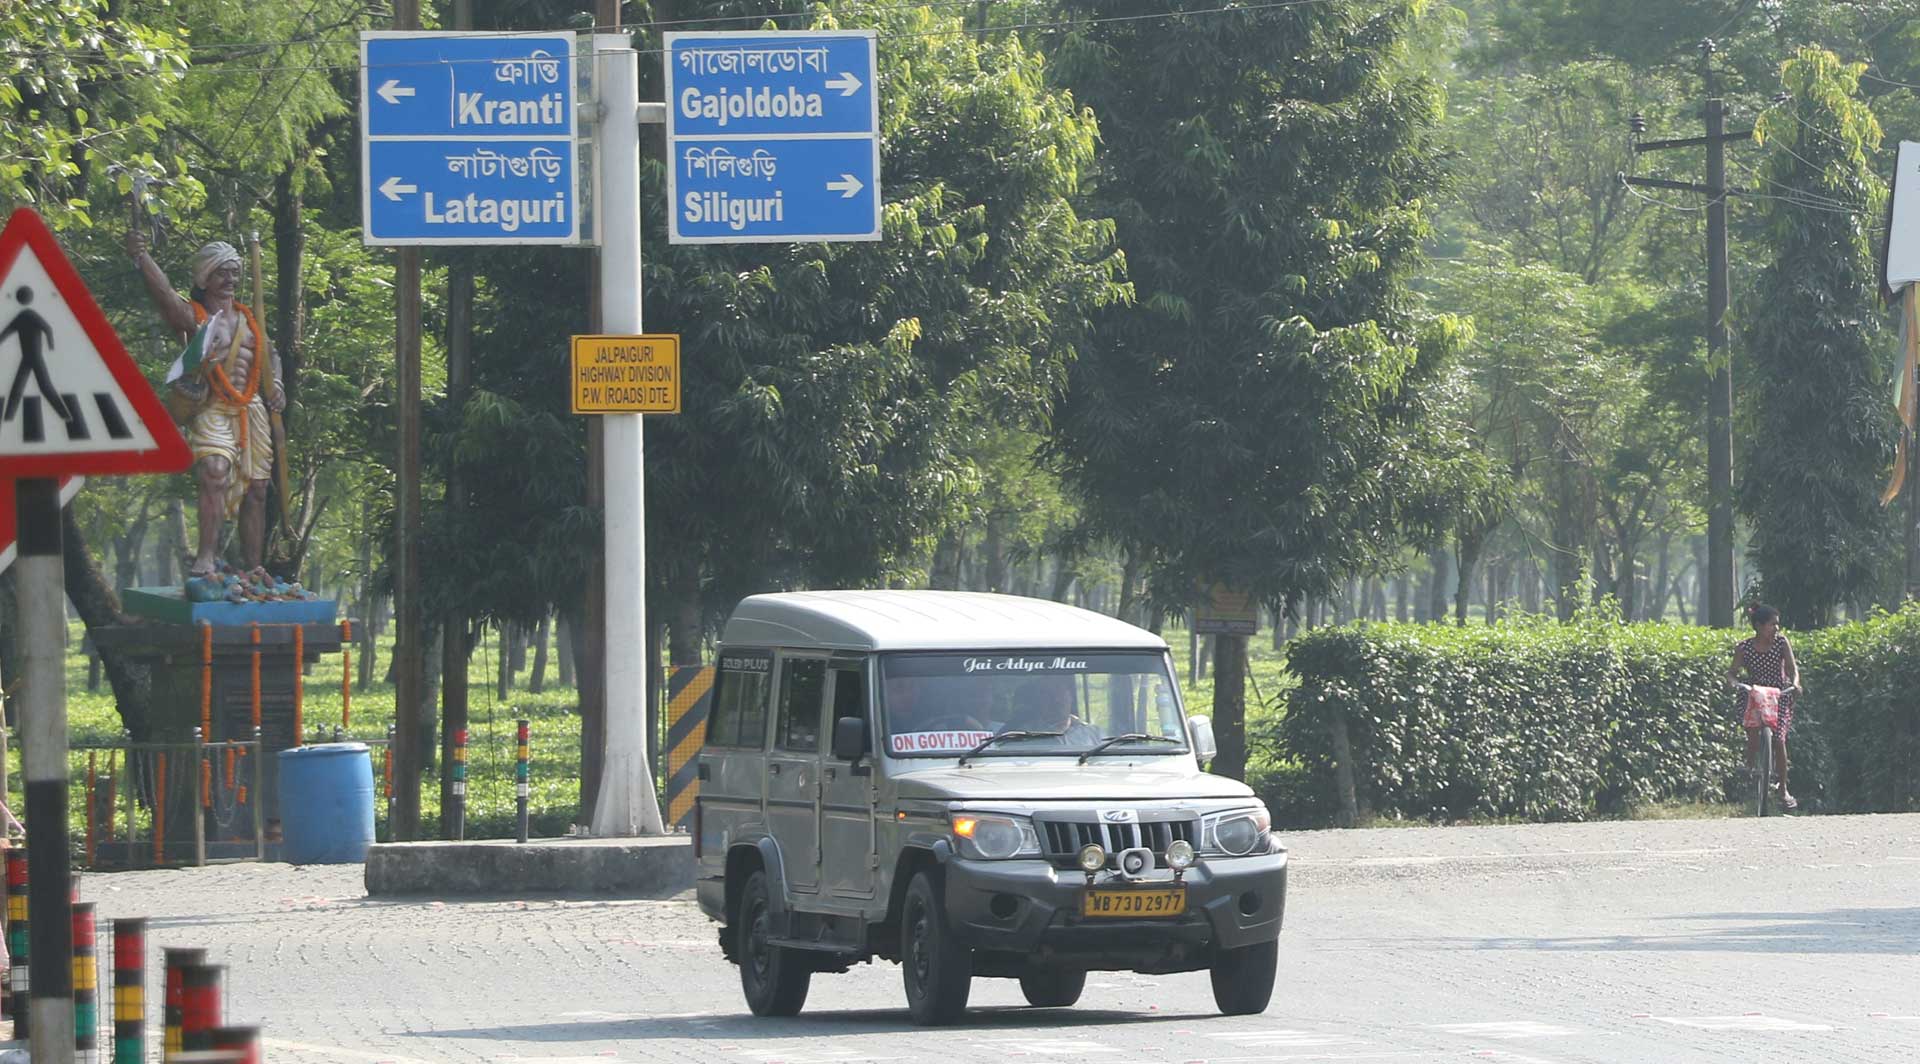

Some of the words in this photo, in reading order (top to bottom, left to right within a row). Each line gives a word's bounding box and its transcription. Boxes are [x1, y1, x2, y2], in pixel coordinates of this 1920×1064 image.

[493, 50, 560, 85] ক্রান্তি
[680, 46, 829, 76] গাজোলডোবা
[459, 92, 562, 125] Kranti
[681, 86, 823, 127] Gajoldoba
[445, 147, 562, 183] লাটাগুড়ি
[684, 146, 777, 182] শিলিগুড়ি
[424, 192, 565, 232] Lataguri
[684, 190, 783, 231] Siliguri
[595, 346, 654, 364] JALPAIGURI
[580, 366, 626, 383] HIGHWAY
[629, 365, 672, 382] DIVISION
[583, 387, 602, 404] P.W.
[605, 385, 646, 406] (ROADS)
[649, 387, 672, 404] DTE.
[963, 657, 993, 673] Jai
[996, 657, 1045, 672] Adya
[1047, 657, 1088, 669] Maa
[894, 735, 914, 751] ON
